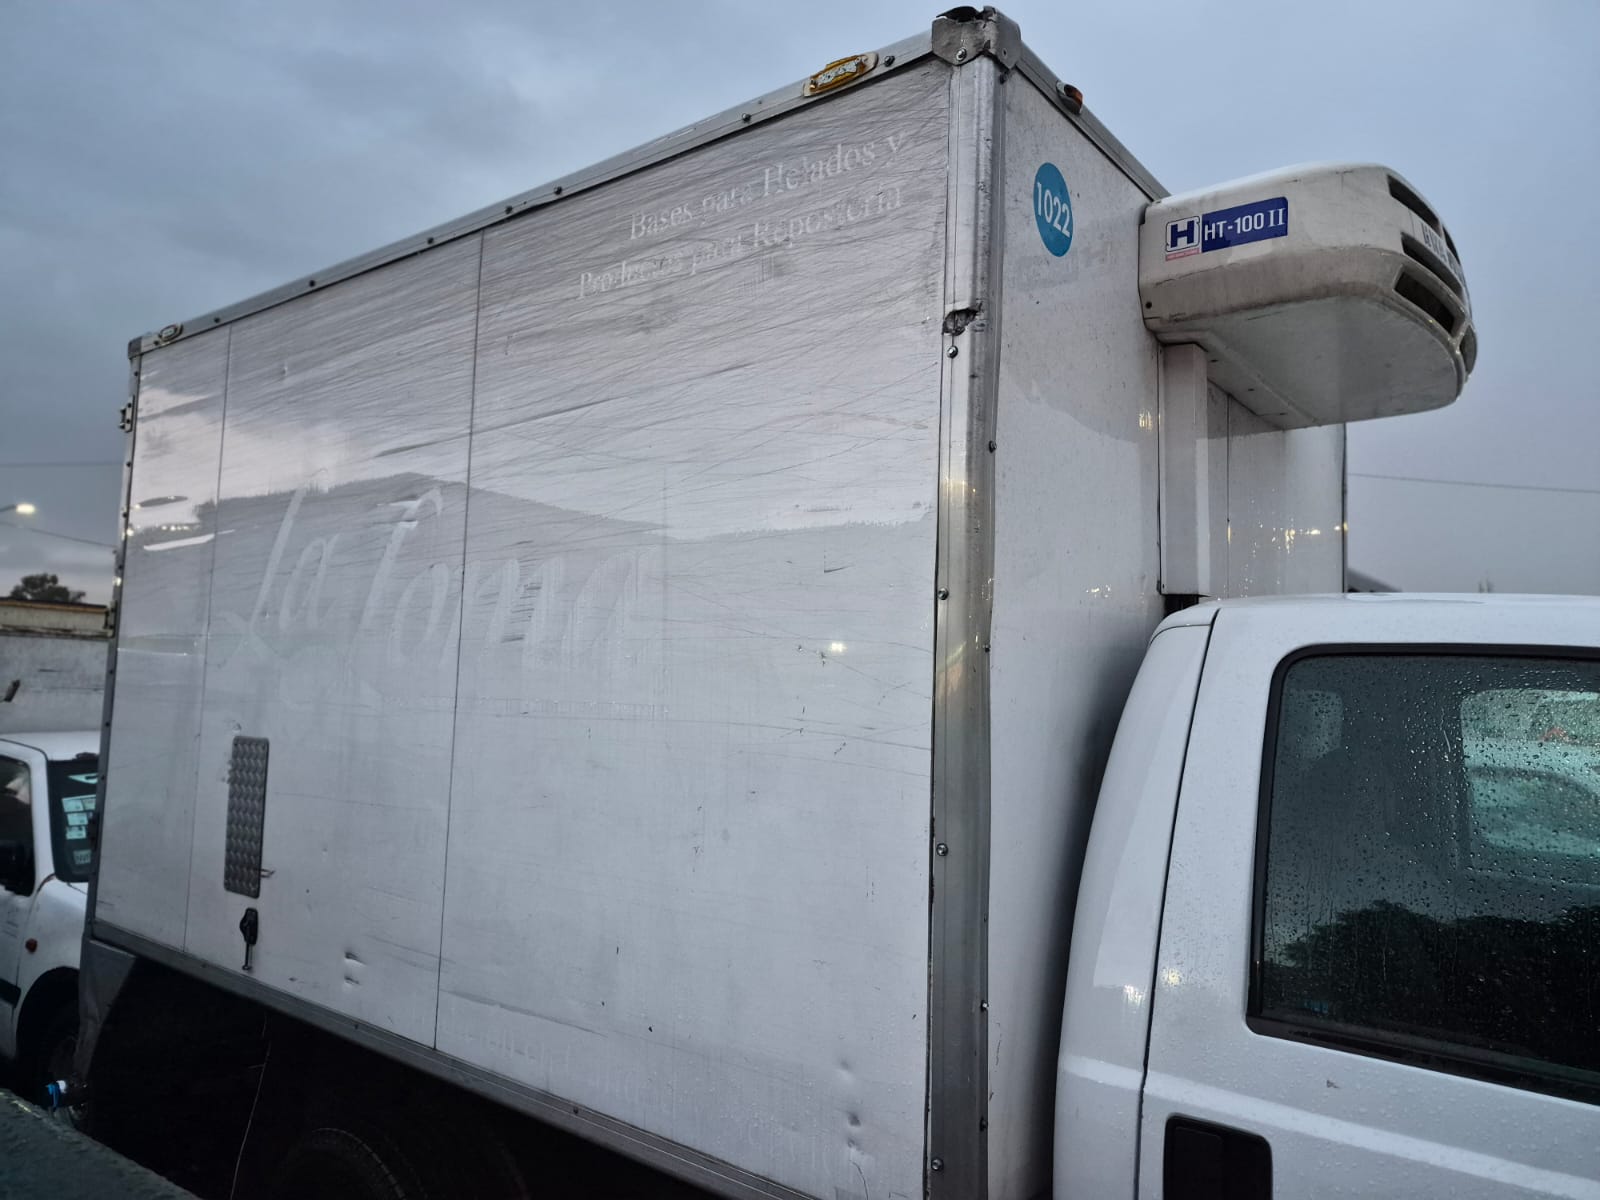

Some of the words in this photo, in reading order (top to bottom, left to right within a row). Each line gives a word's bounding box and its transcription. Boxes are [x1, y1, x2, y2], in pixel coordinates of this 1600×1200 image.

[630, 203, 693, 240] Bases
[762, 143, 877, 198] Helados
[1036, 181, 1071, 239] 1022
[1203, 211, 1265, 241] HT-100
[1266, 207, 1286, 228] II
